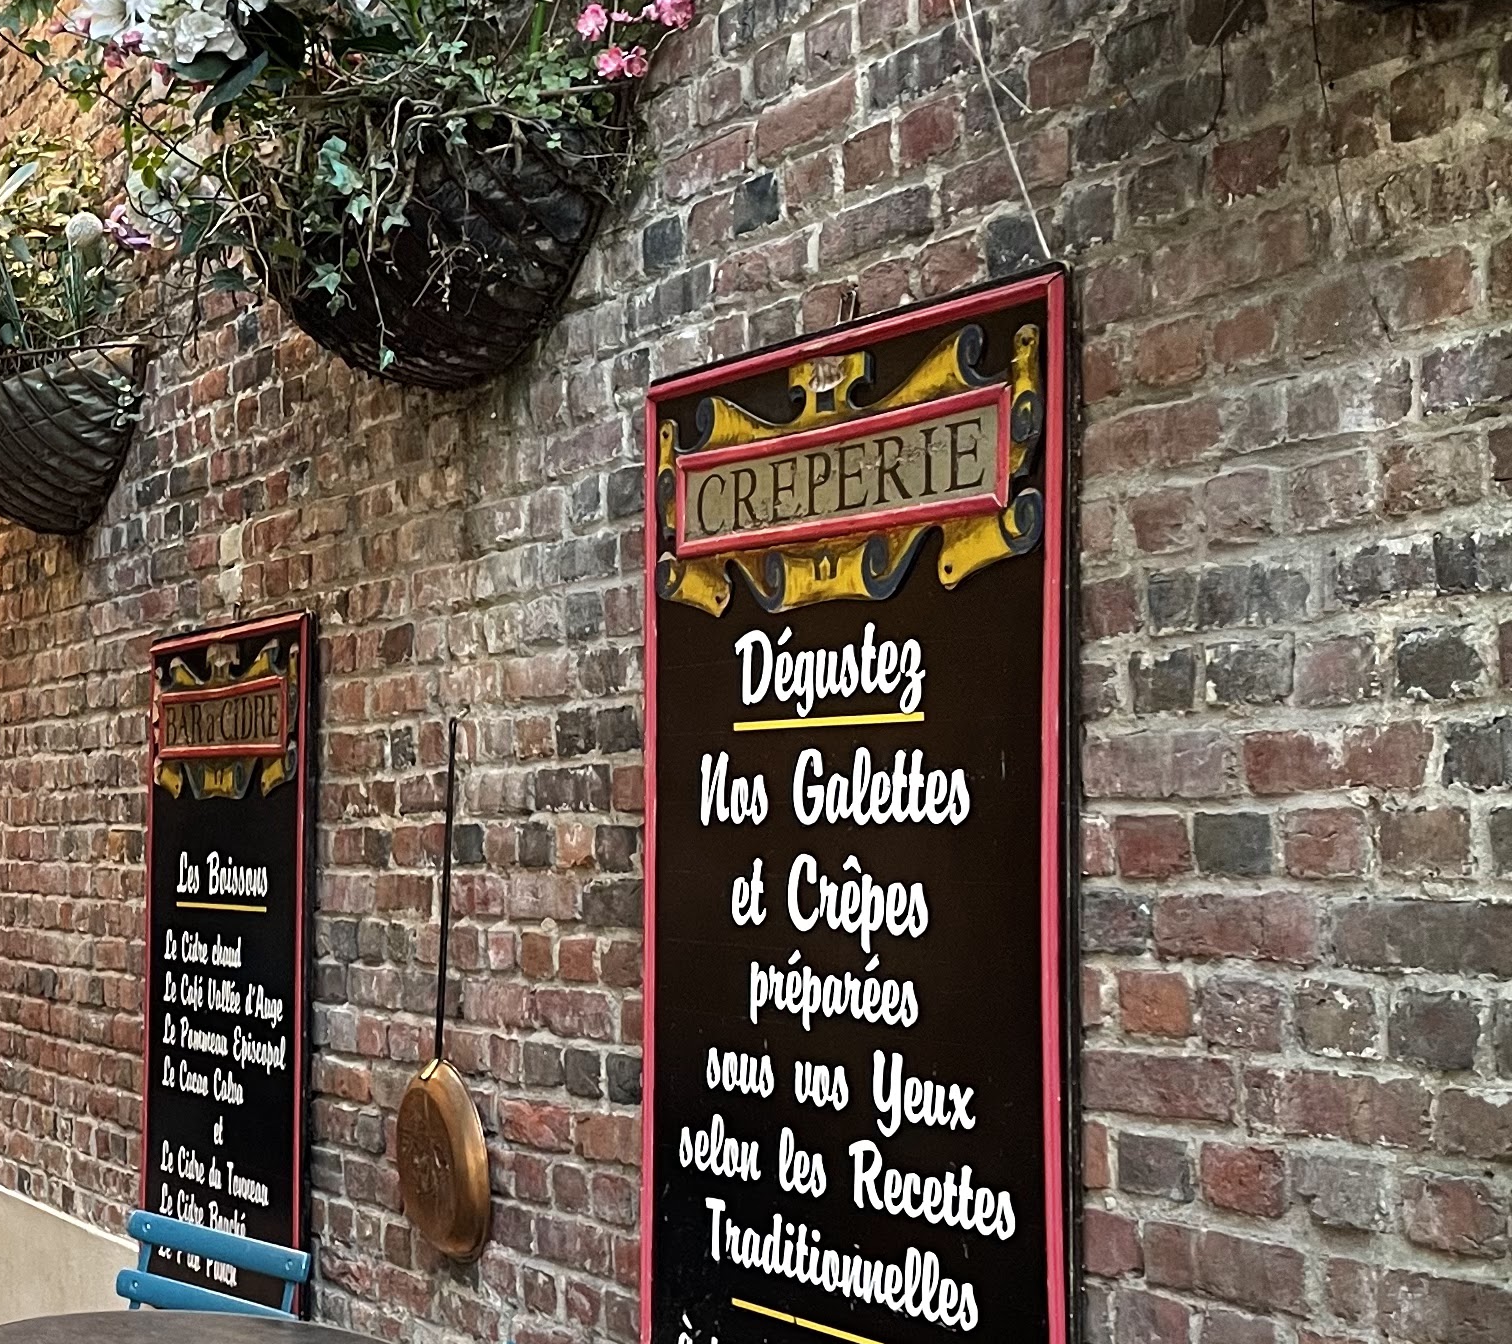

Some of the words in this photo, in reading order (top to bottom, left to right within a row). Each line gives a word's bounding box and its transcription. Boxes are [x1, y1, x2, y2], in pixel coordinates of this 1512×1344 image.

[696, 417, 986, 535] CREPERIE
[734, 622, 926, 716] Dégustez
[166, 704, 203, 746] BAR
[700, 751, 769, 827] Nos
[792, 746, 971, 826] Galettes
[176, 851, 200, 895] Les
[206, 850, 268, 898] Boissons
[731, 857, 767, 926] et
[787, 853, 929, 953] Crêpes
[163, 928, 178, 961] Le
[181, 930, 209, 965] Cidre
[211, 933, 242, 969] chaud
[163, 970, 177, 1003] Le
[180, 973, 204, 1012] Café
[207, 977, 241, 1015] Vallée
[244, 983, 284, 1029] d'Auge
[749, 948, 919, 1030] préparées
[162, 1012, 176, 1046] Le
[179, 1015, 229, 1057] Pommeau
[232, 1025, 287, 1076] Episcopal
[161, 1054, 175, 1088] Le
[213, 1067, 244, 1106] Calva
[706, 1046, 775, 1099] sous
[794, 1060, 849, 1111] vos
[872, 1049, 976, 1138] Yeux
[213, 1116, 224, 1146] et
[160, 1139, 174, 1174] Le
[177, 1145, 206, 1185] Cidre
[208, 1155, 223, 1190] du
[678, 1113, 762, 1182] selon
[778, 1126, 827, 1198] les
[848, 1139, 1016, 1241] Recettes
[159, 1182, 174, 1216] Le
[176, 1188, 205, 1227] Cidre
[705, 1197, 979, 1332] Traditionnelles
